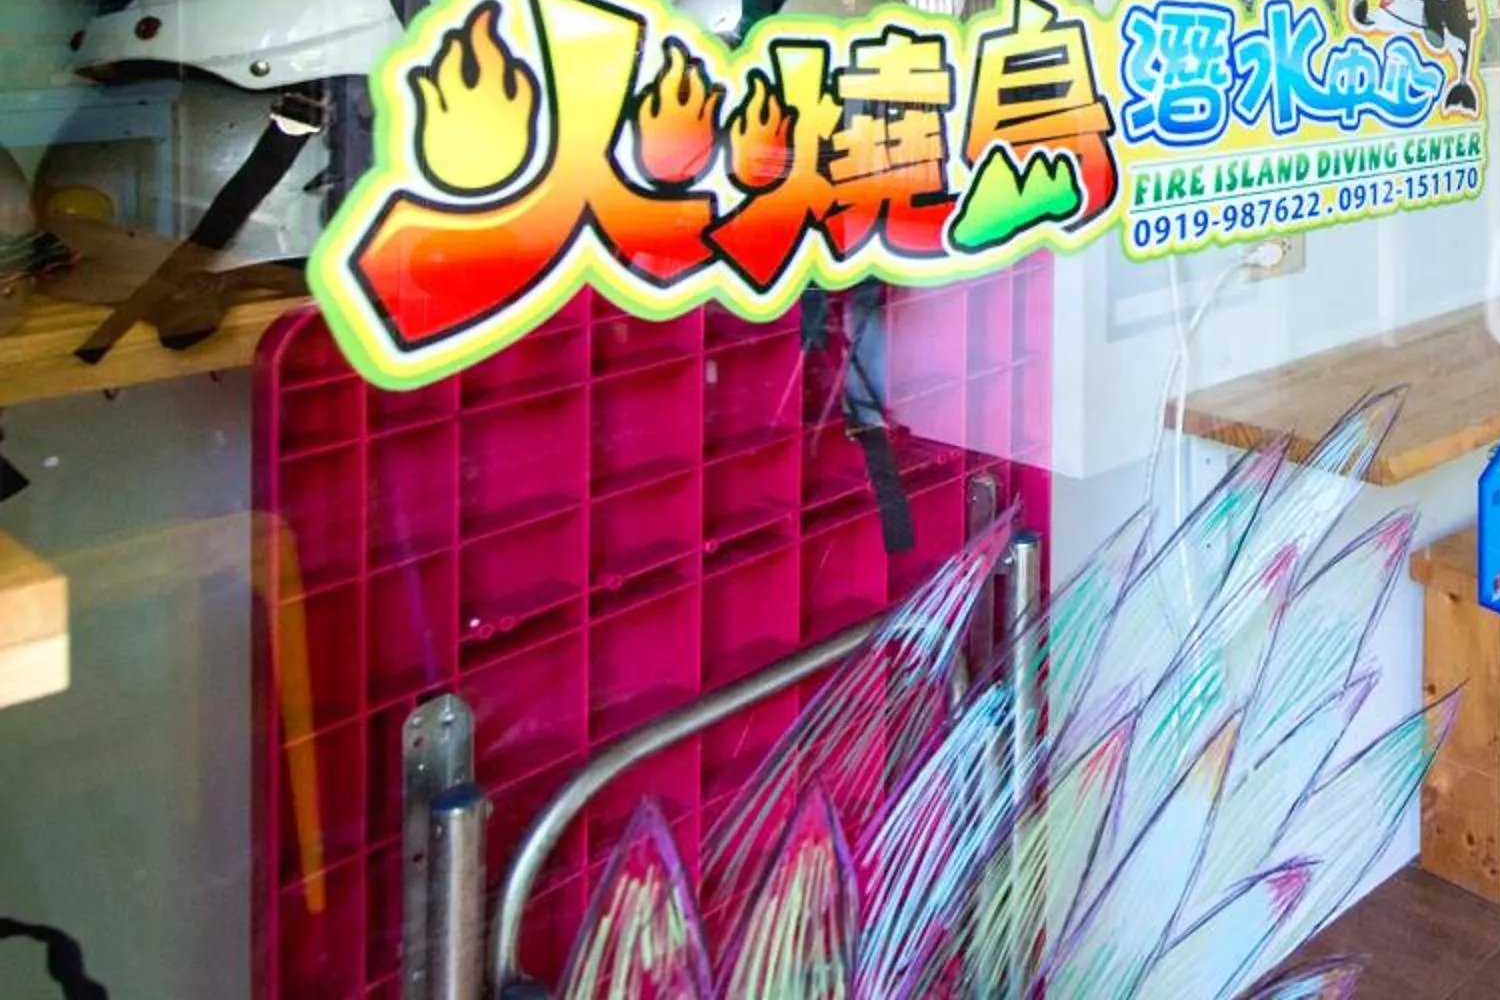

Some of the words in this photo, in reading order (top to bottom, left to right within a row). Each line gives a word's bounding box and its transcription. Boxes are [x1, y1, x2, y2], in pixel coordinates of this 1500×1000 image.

[1134, 161, 1205, 206] FIRE
[1214, 152, 1310, 195] ISLAND
[1317, 141, 1398, 181] DIVING
[1403, 131, 1482, 163] CENTER
